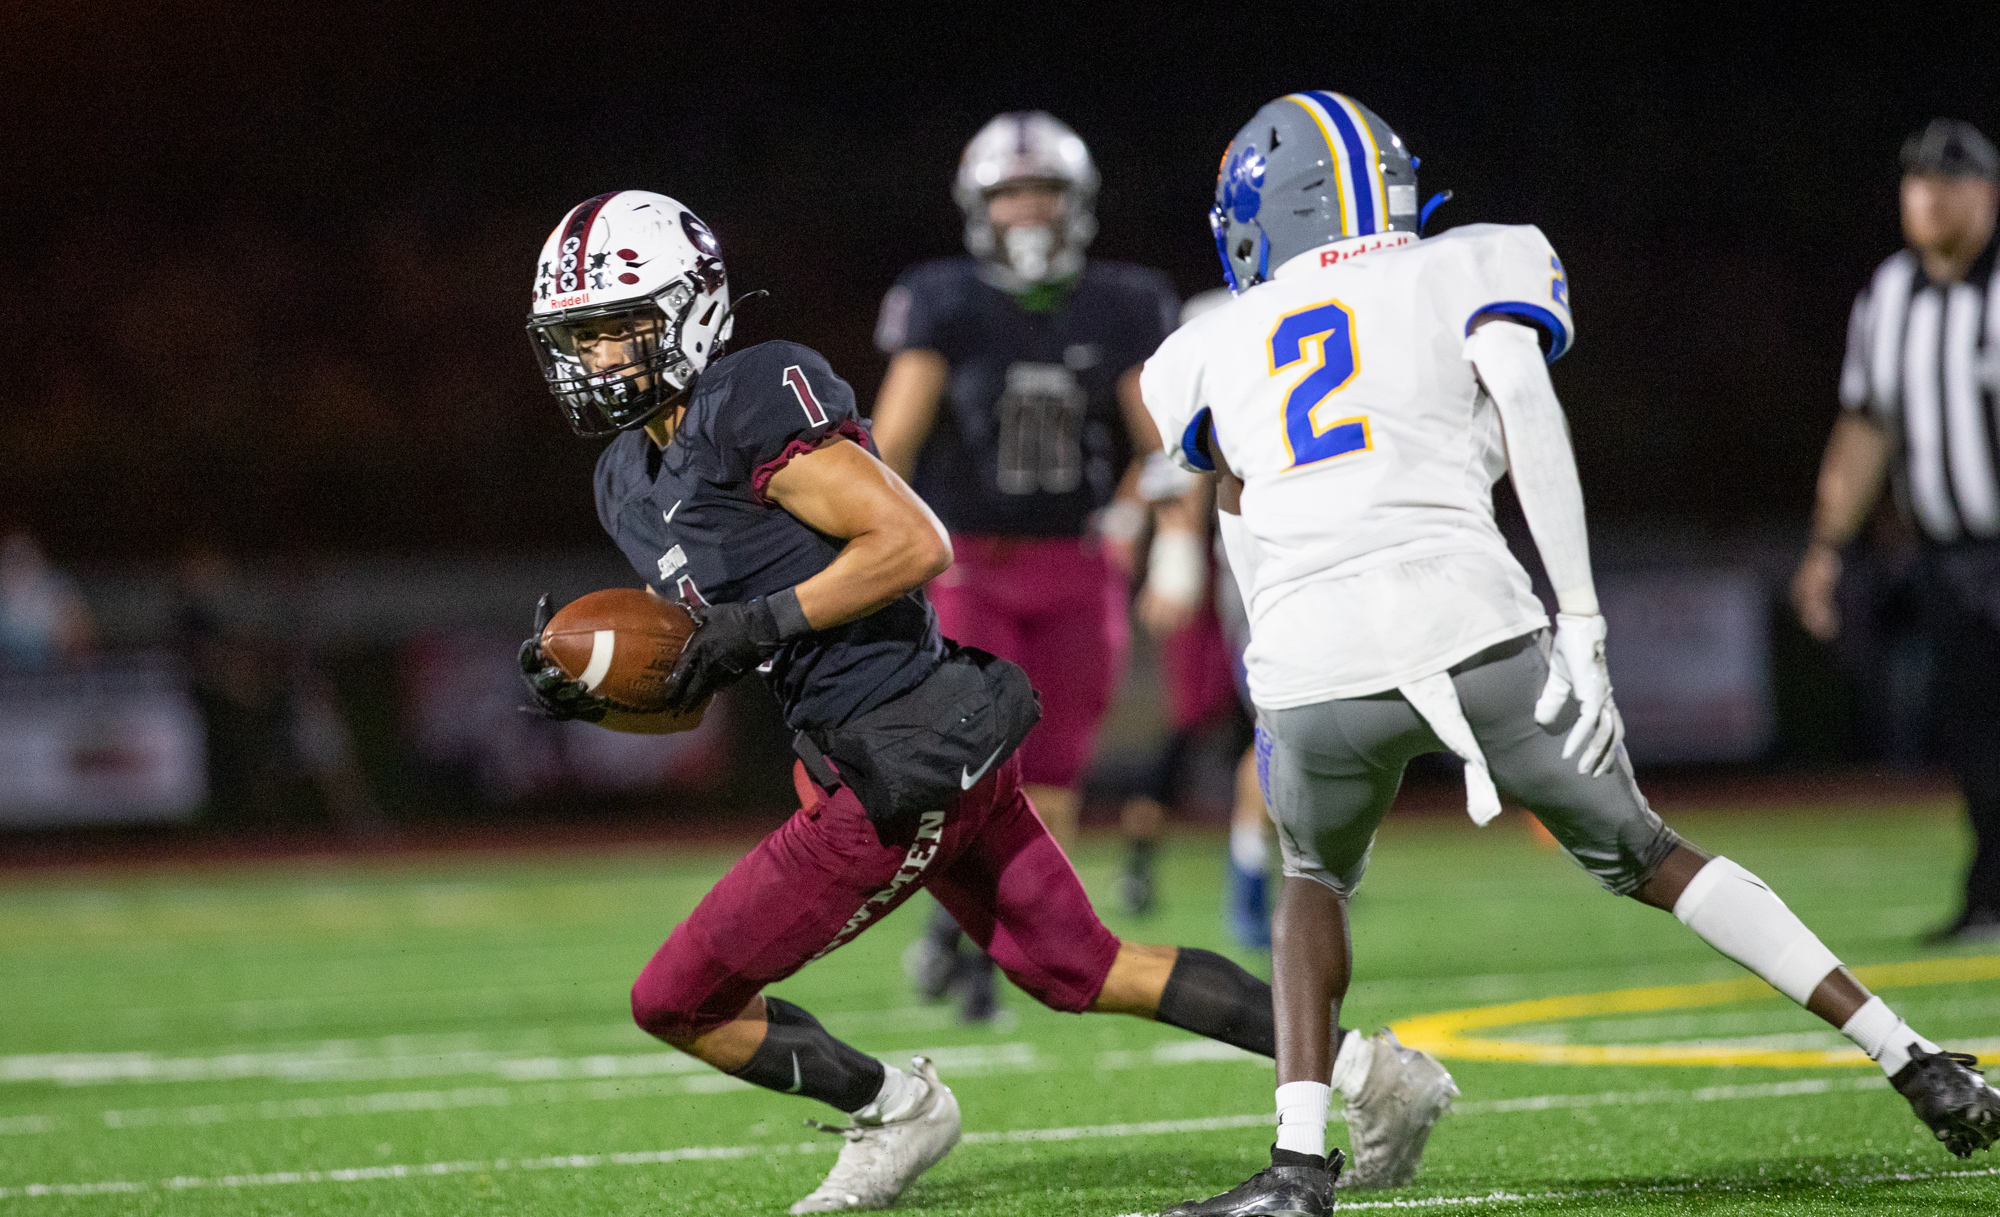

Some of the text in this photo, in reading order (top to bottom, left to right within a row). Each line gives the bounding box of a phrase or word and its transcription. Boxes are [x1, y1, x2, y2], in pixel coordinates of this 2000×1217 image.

[551, 293, 590, 309] Riddell
[782, 365, 829, 428] 1
[1266, 297, 1374, 473] 2
[802, 810, 946, 967] WMEN
